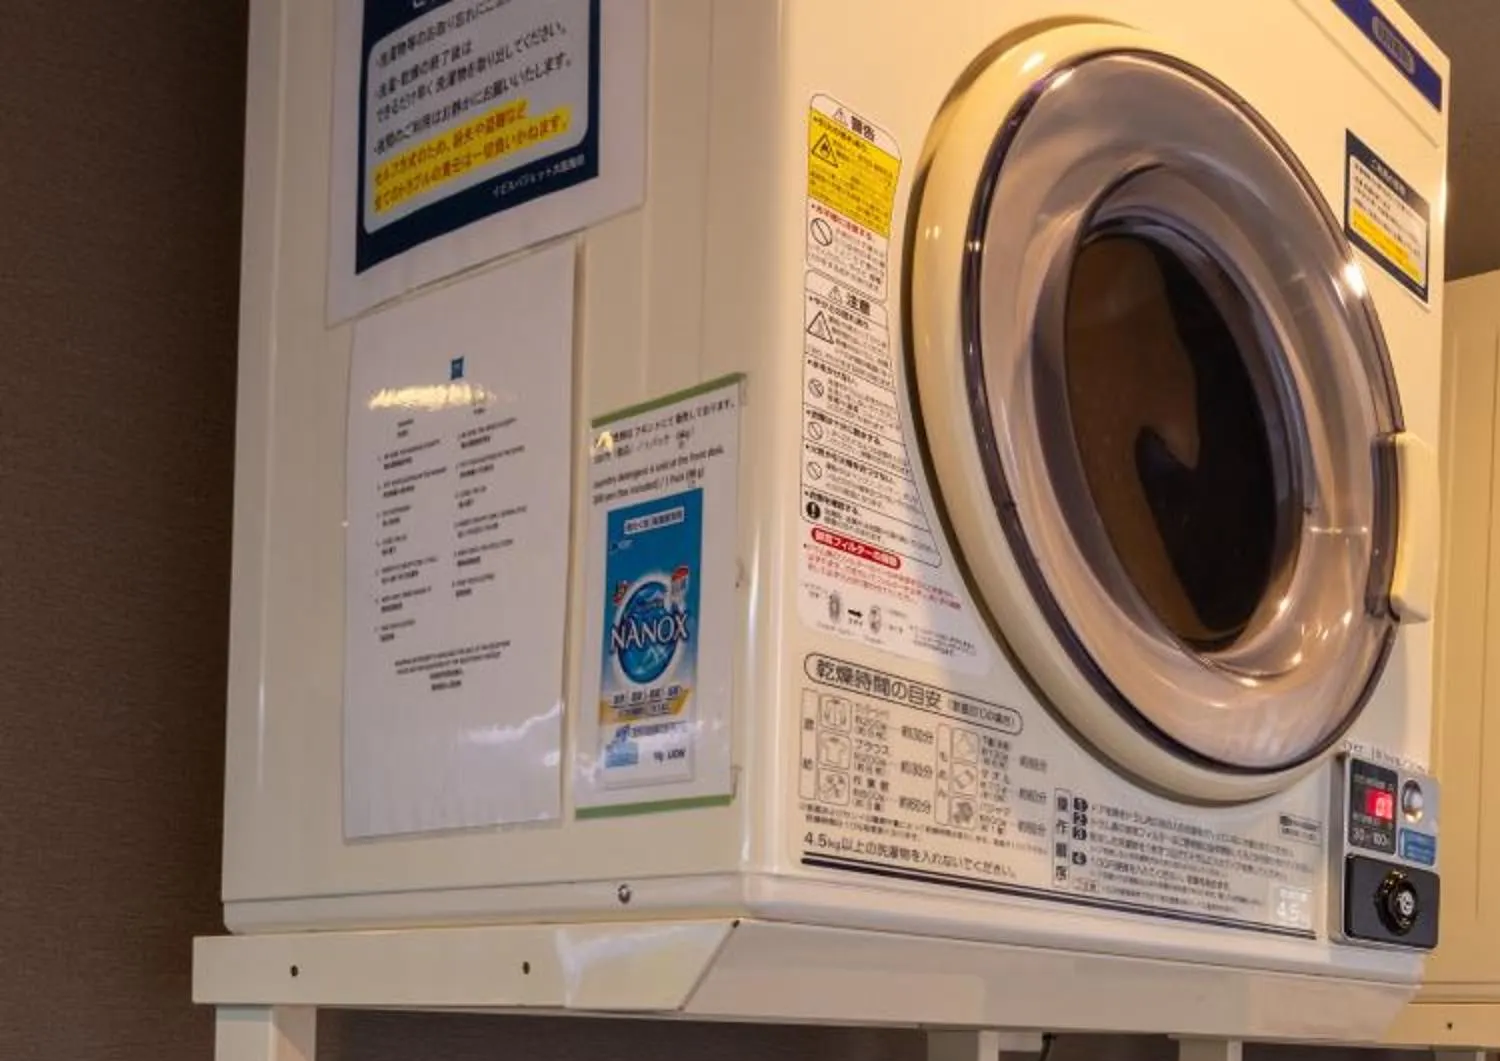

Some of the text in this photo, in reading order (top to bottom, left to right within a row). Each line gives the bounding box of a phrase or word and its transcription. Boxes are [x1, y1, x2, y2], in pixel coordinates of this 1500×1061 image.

[610, 614, 688, 648] NANOX
[816, 660, 942, 709] 乾燥時間の目安
